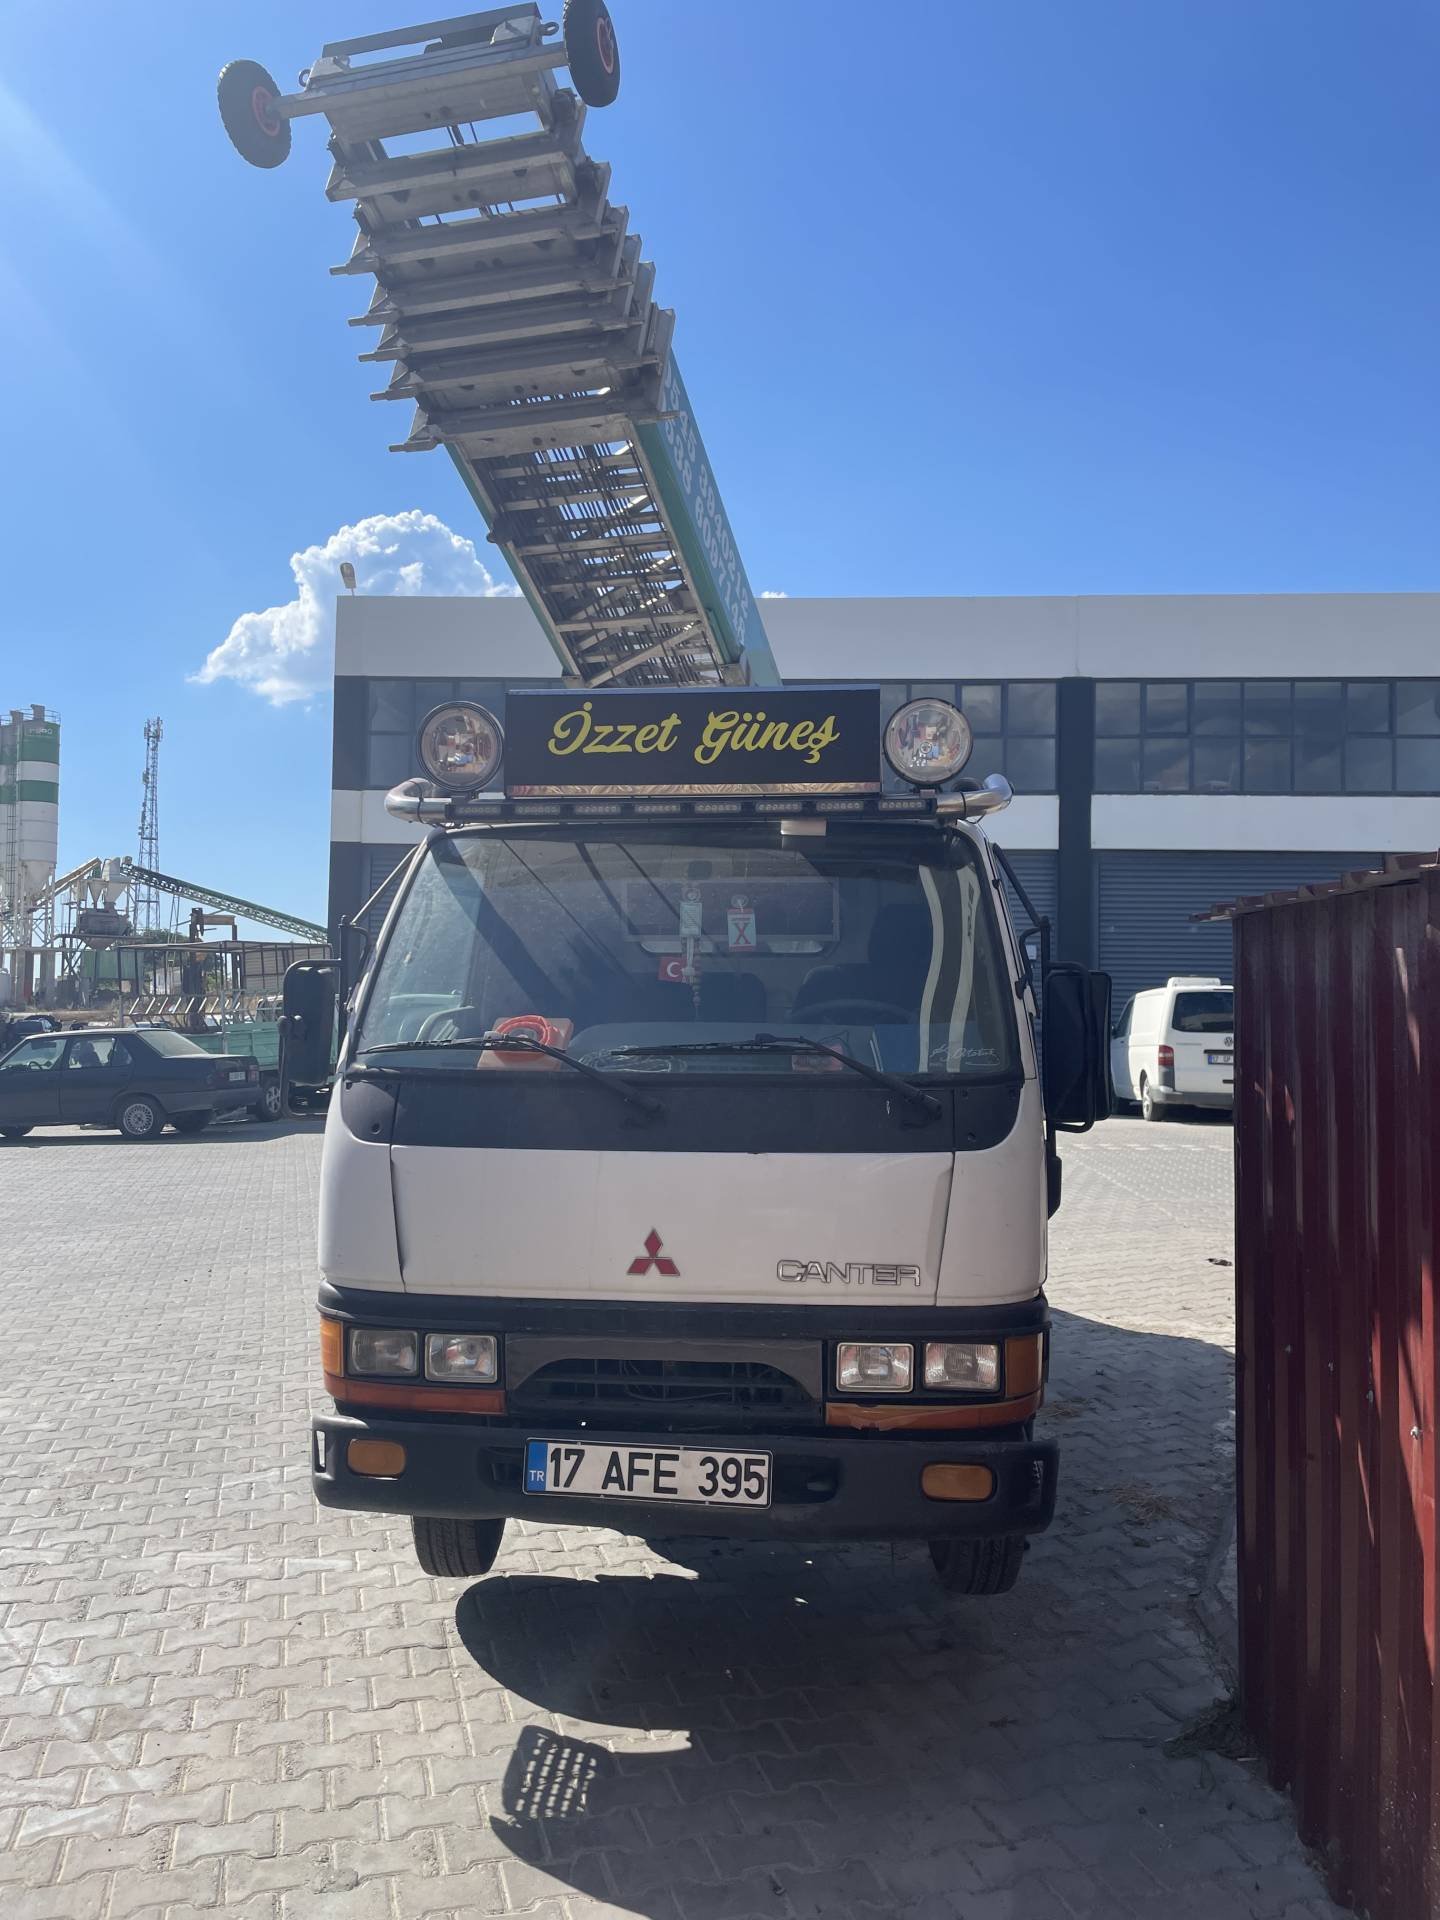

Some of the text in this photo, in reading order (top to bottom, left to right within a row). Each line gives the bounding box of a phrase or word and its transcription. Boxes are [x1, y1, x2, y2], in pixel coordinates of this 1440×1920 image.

[547, 701, 840, 764] İzzet Güneş
[777, 1259, 921, 1287] CANTER
[529, 1447, 766, 1500] TR 17 AFE 395
